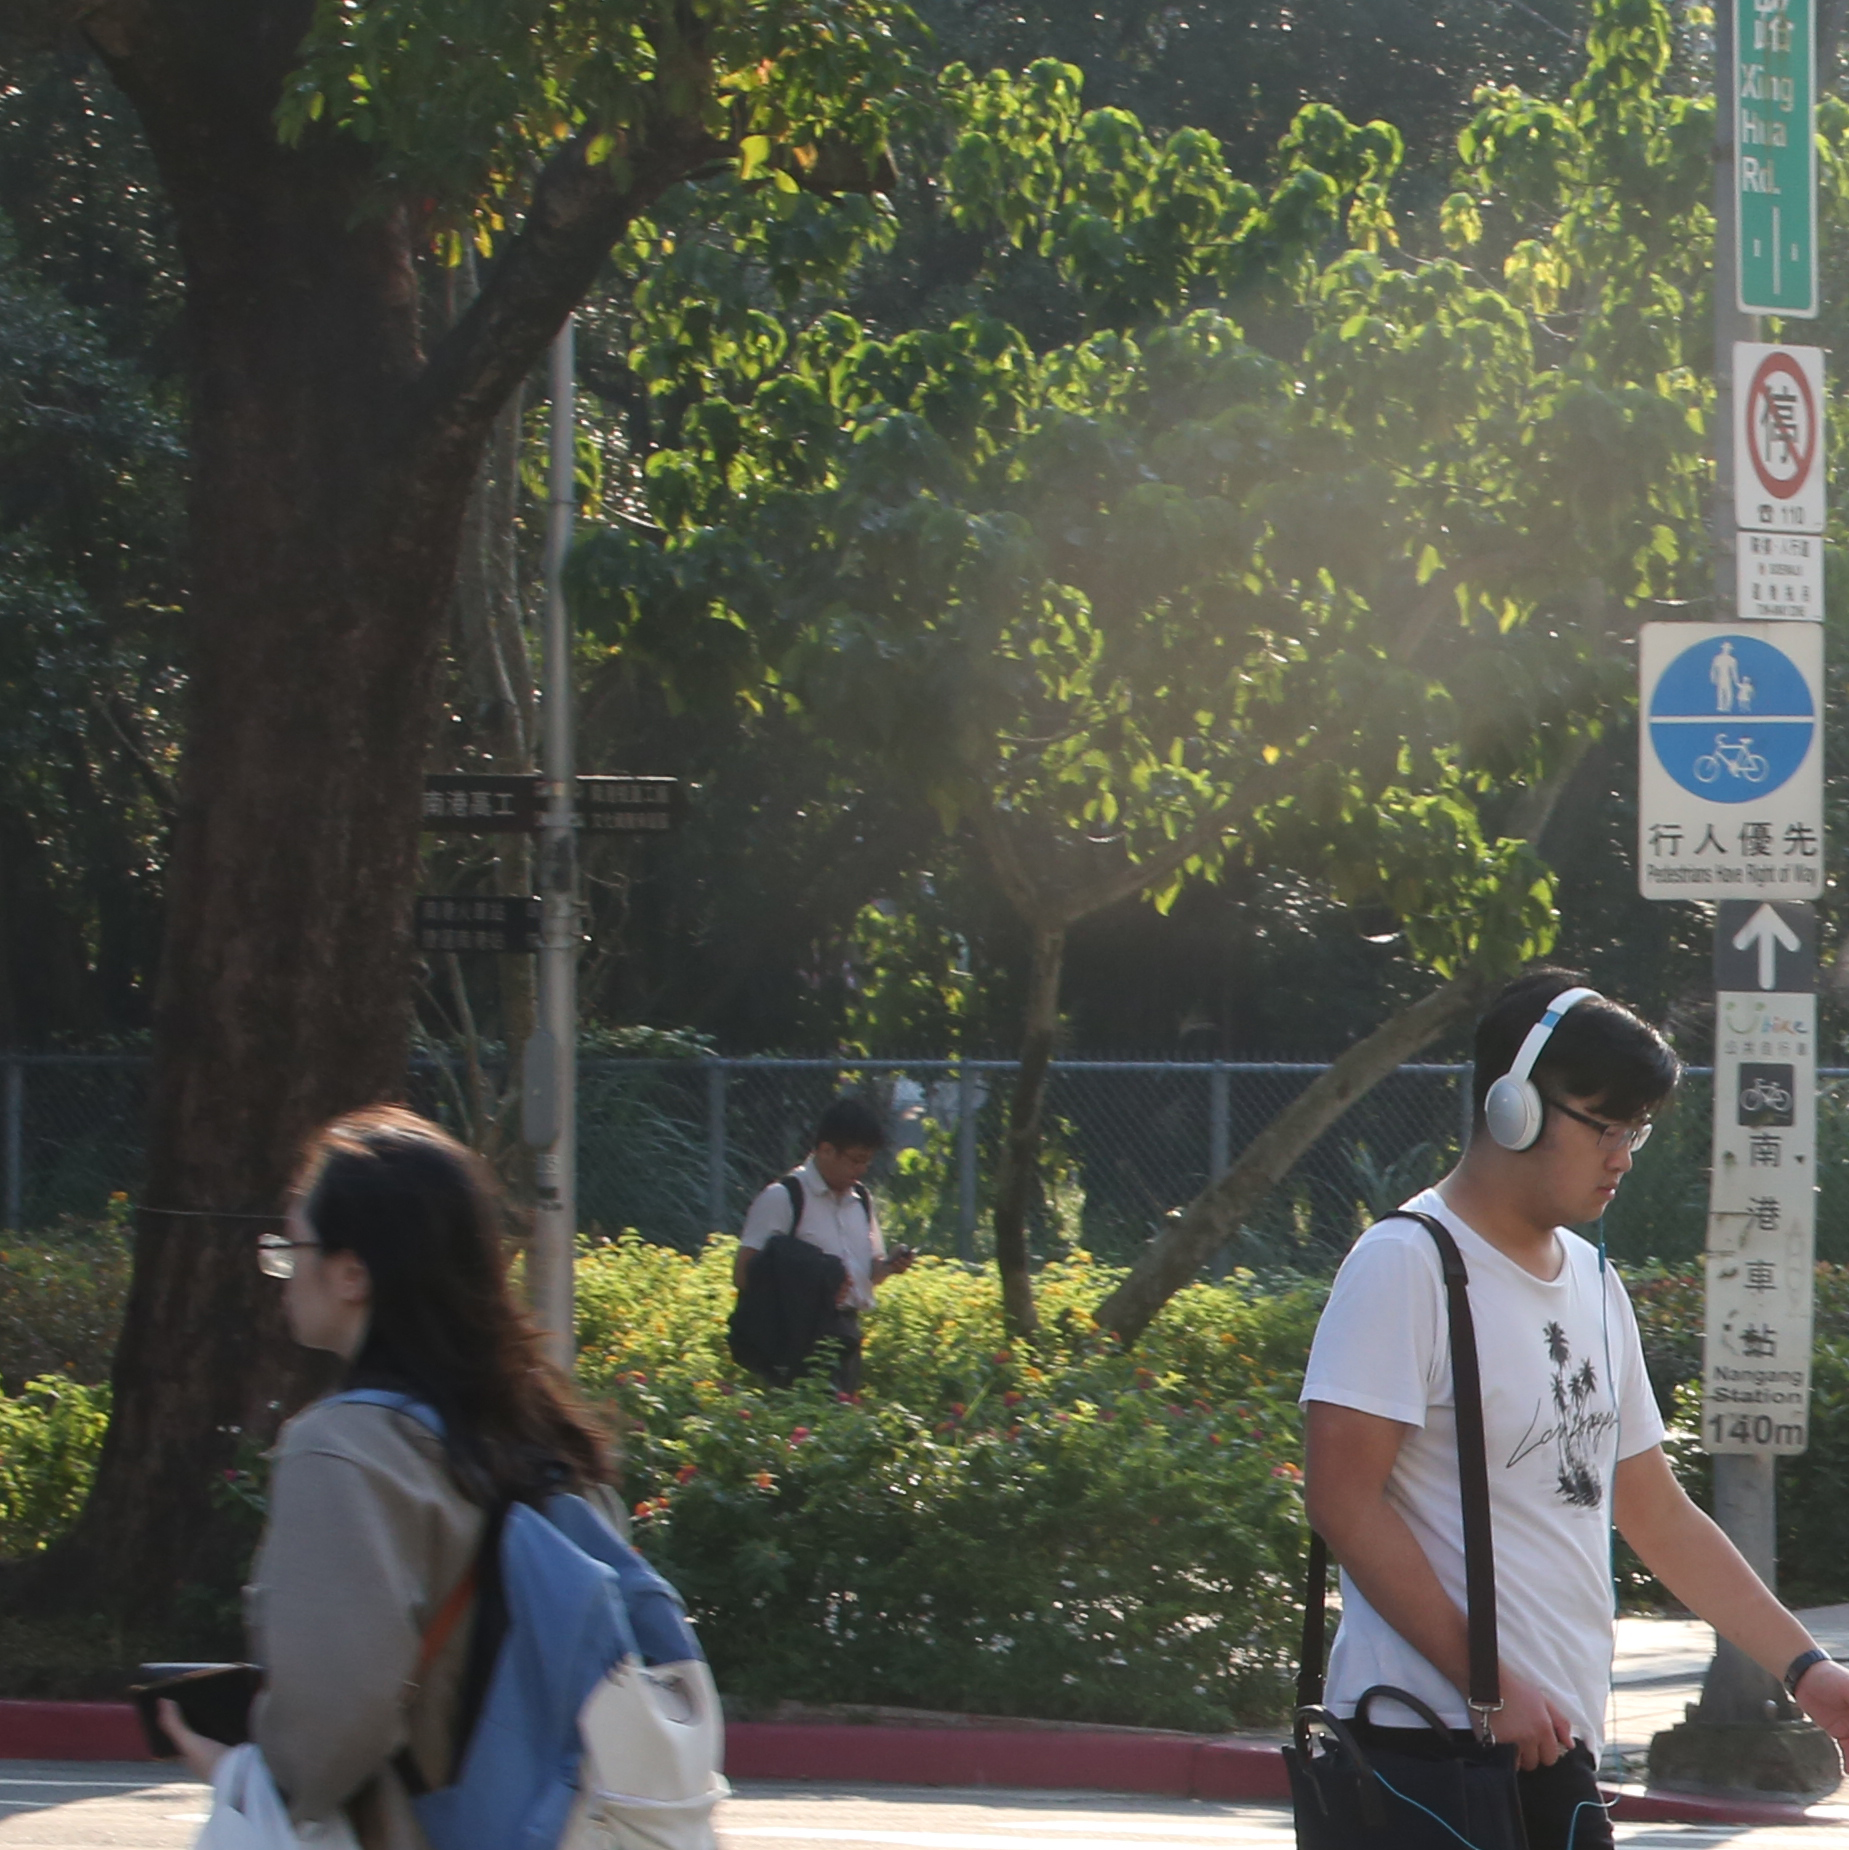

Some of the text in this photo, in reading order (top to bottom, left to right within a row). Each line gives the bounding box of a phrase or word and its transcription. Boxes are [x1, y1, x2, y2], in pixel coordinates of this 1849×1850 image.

[1741, 63, 1794, 112] Xing
[1742, 108, 1787, 148] Hua
[1742, 156, 1782, 196] Rd.
[1781, 507, 1805, 525] 110
[1646, 820, 1819, 859] 行人優先
[1646, 863, 1819, 888] Pedestrians Have Right of Way
[1740, 1131, 1784, 1359] 南港車站
[1713, 1365, 1805, 1388] Nangang
[1713, 1386, 1802, 1404] Station
[1708, 1414, 1804, 1446] 140m
